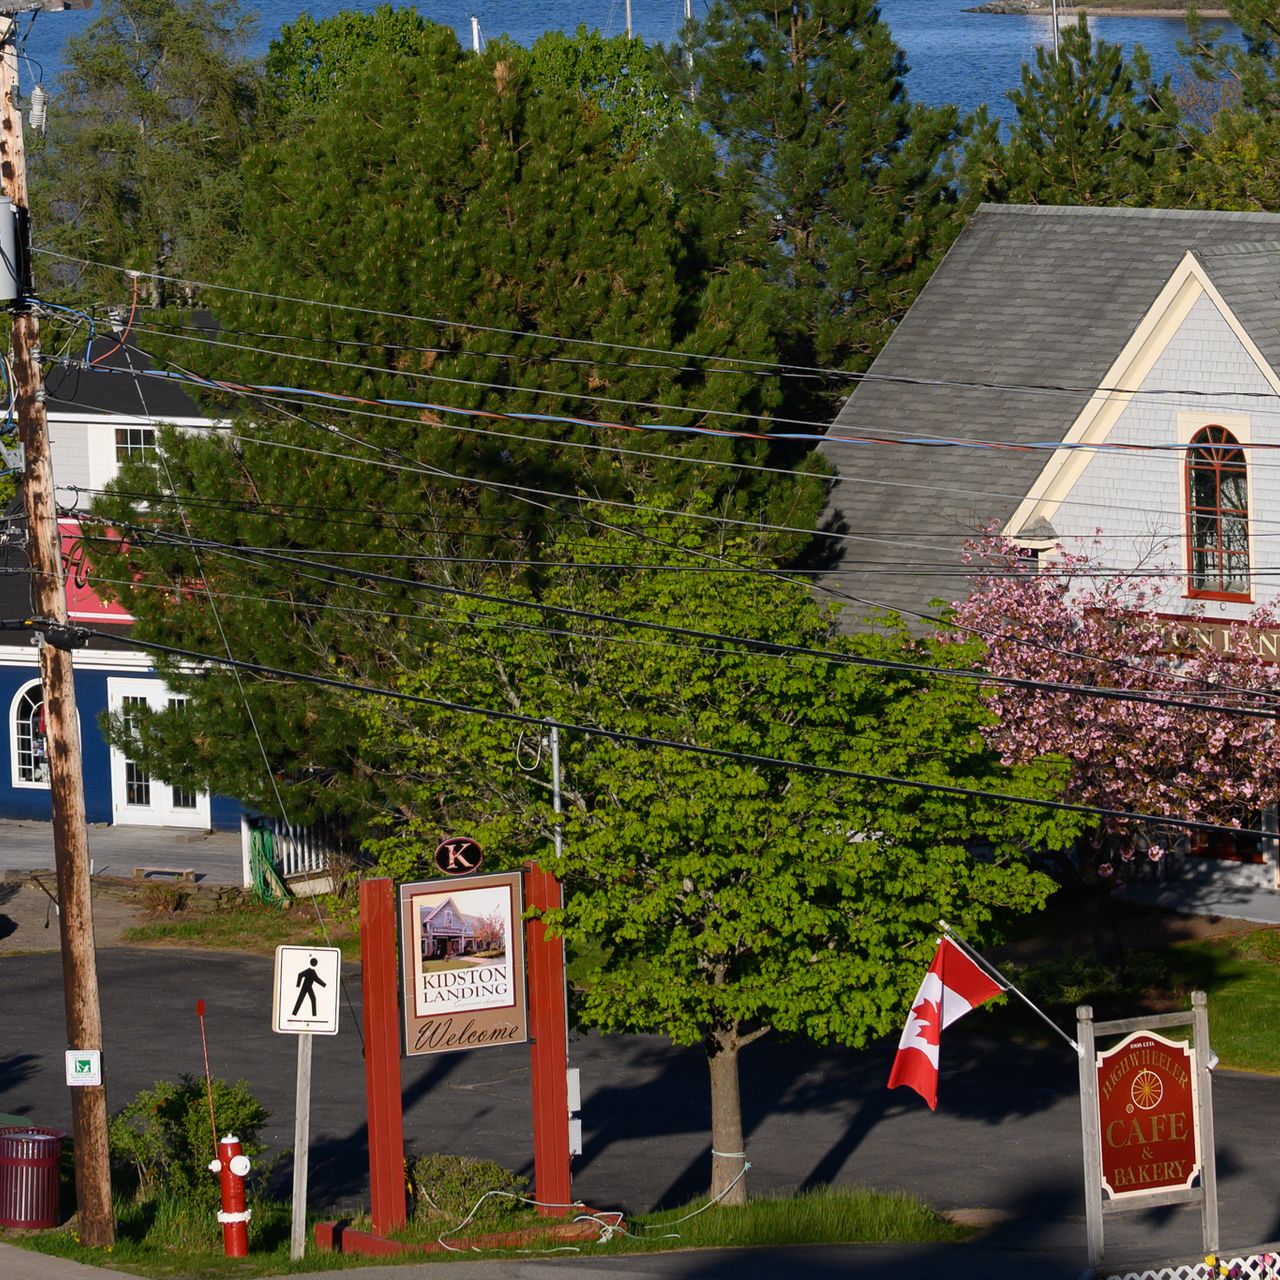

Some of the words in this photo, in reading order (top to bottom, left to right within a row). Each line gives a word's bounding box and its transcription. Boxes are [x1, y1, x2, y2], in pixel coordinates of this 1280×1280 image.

[444, 843, 473, 870] K
[422, 966, 507, 991] KIDSTON
[424, 982, 508, 1004] LANDING
[414, 1018, 519, 1051] Welcome
[1106, 1112, 1188, 1148] CAFE
[1141, 1146, 1155, 1160] &
[1114, 1160, 1186, 1187] BAKERY
